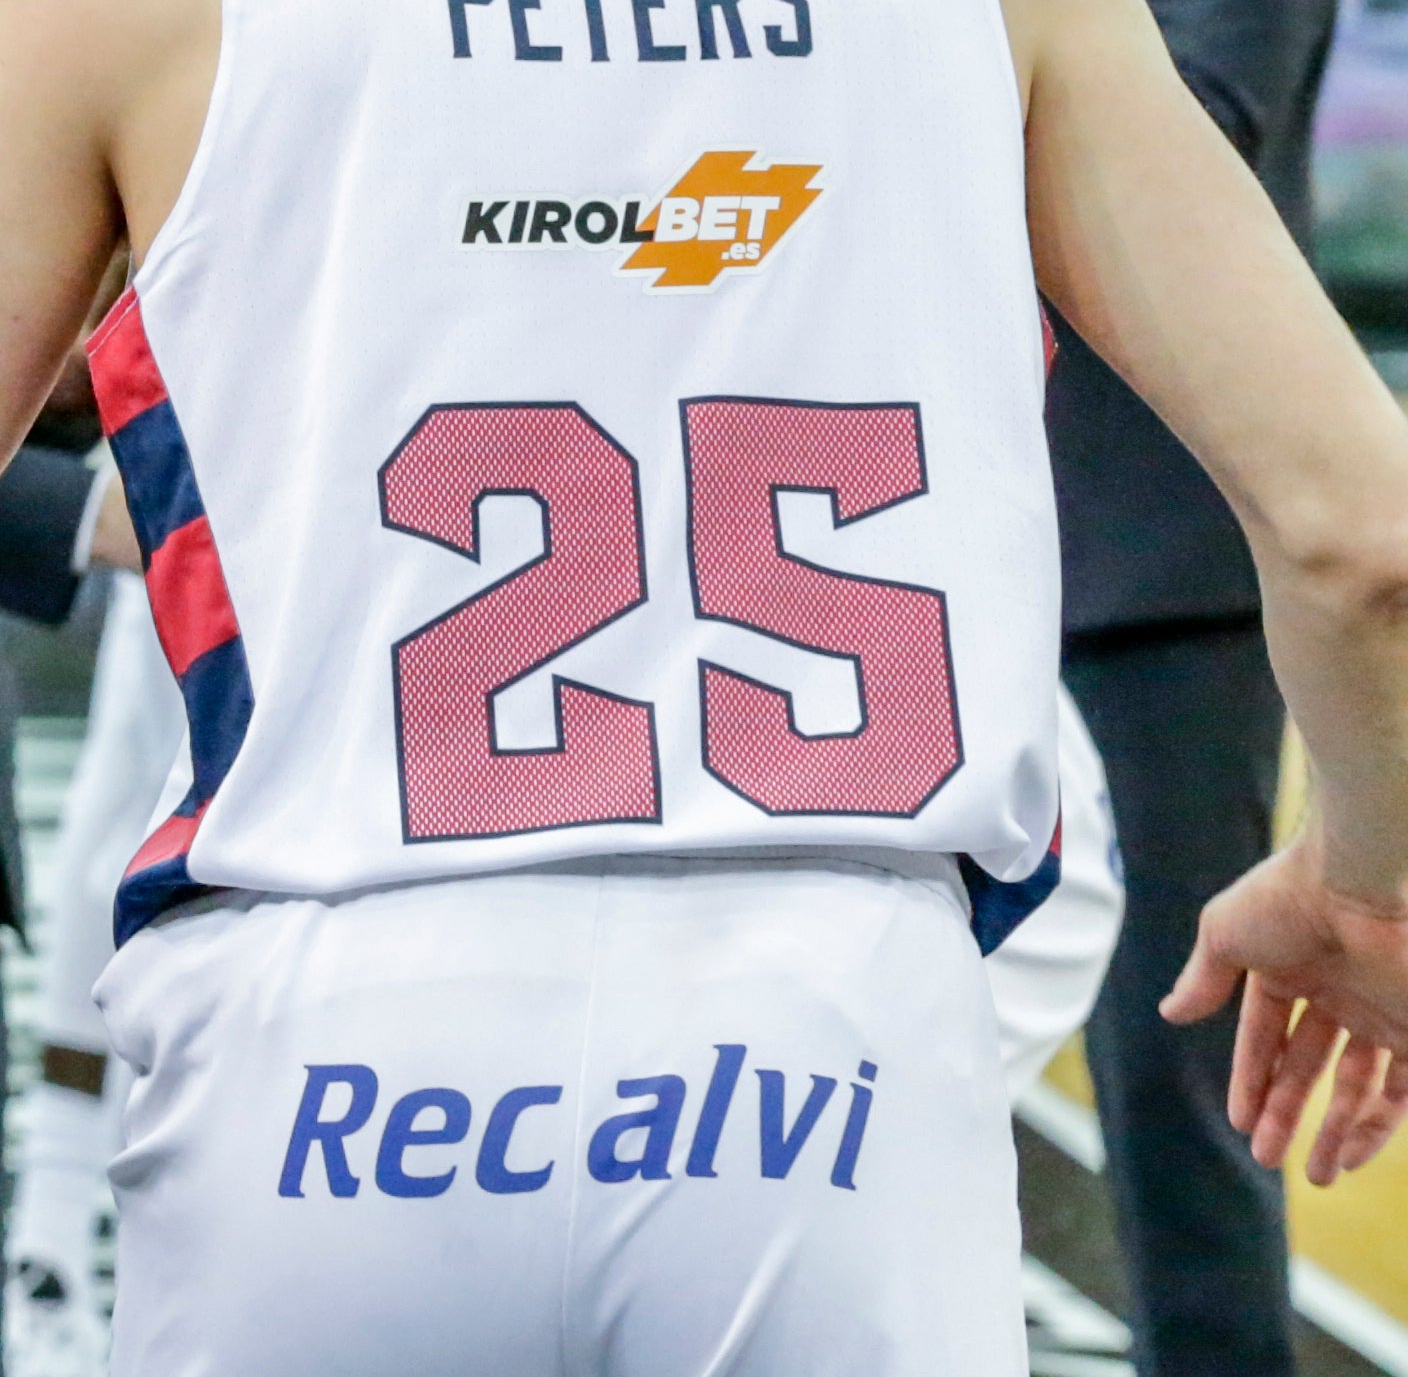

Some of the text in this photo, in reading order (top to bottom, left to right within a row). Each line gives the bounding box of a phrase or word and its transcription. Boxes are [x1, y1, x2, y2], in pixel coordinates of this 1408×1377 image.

[461, 194, 782, 244] KIROLBET
[377, 395, 965, 845] 25
[277, 1043, 878, 1199] Recalvi
